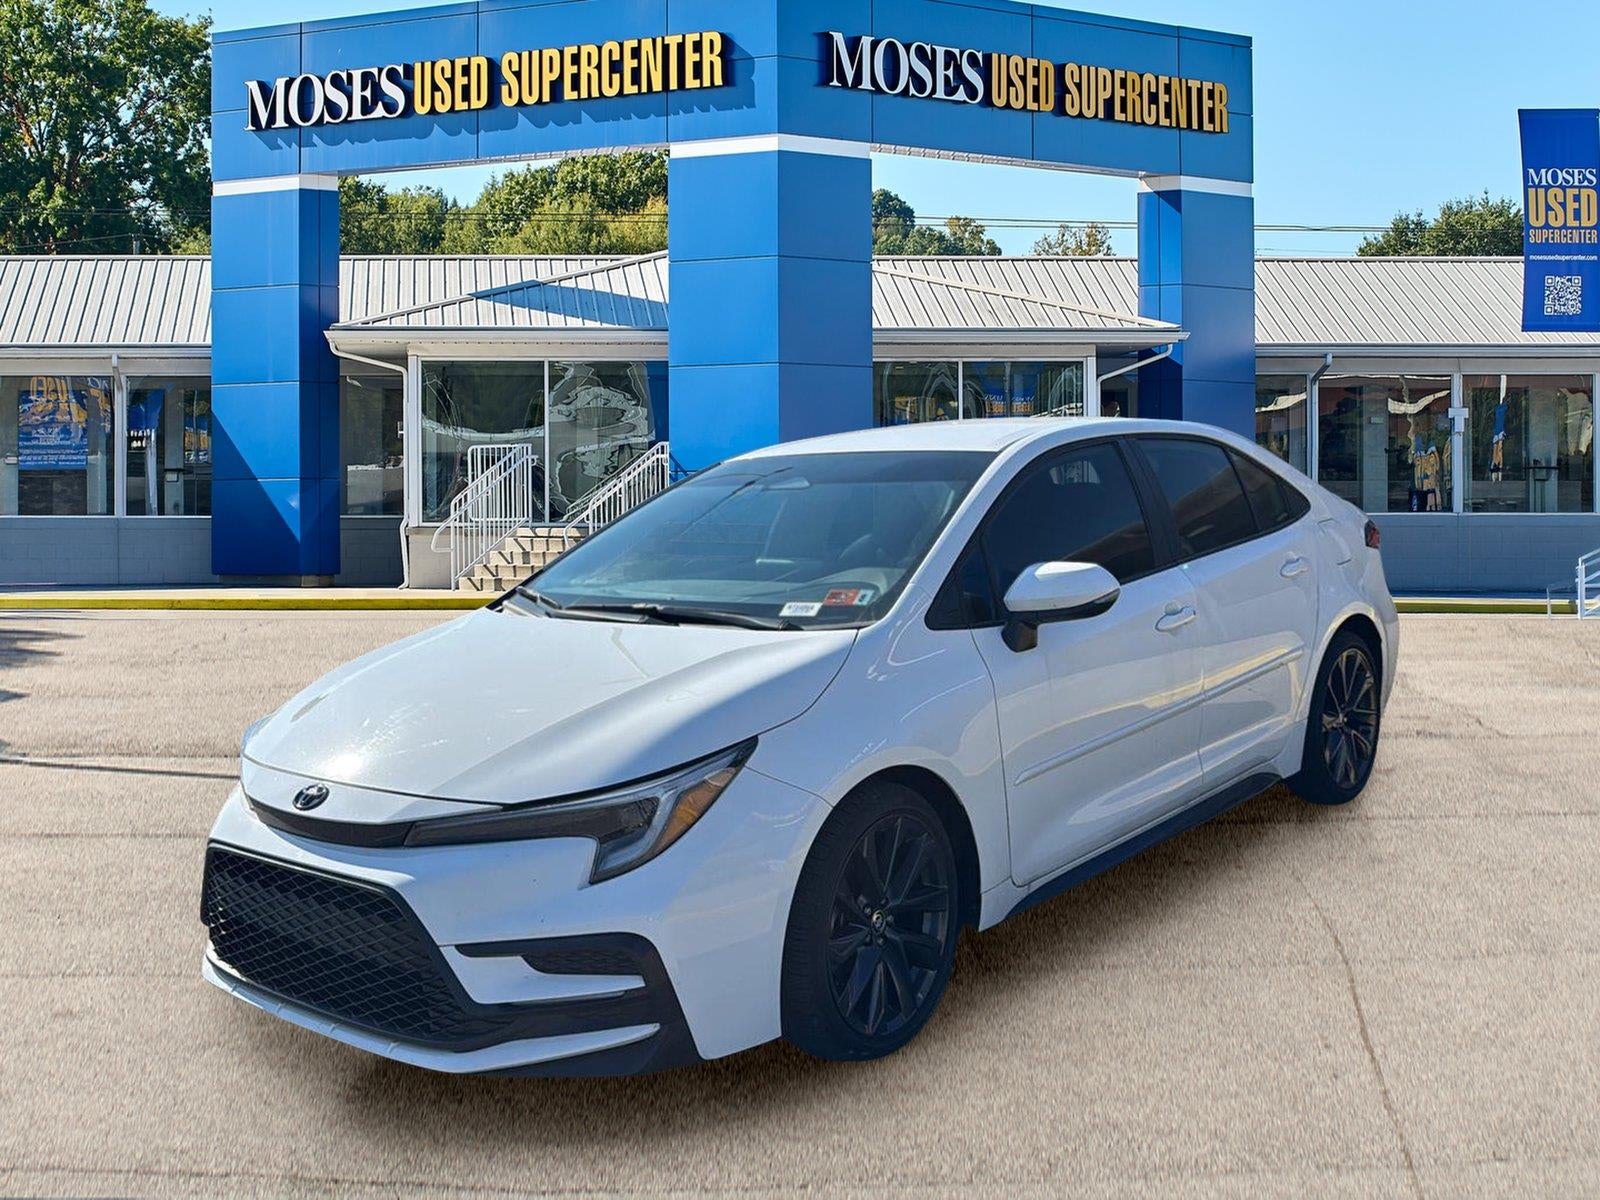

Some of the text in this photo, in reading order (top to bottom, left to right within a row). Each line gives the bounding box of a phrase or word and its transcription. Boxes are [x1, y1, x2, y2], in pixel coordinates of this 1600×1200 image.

[244, 31, 724, 131] MOSES USED SUPERCENTER
[829, 31, 1229, 133] MOSES USED SUPERCENTER
[1528, 168, 1597, 187] MOSES
[1528, 187, 1598, 228] USED
[1529, 229, 1598, 244] SUPERCENTER
